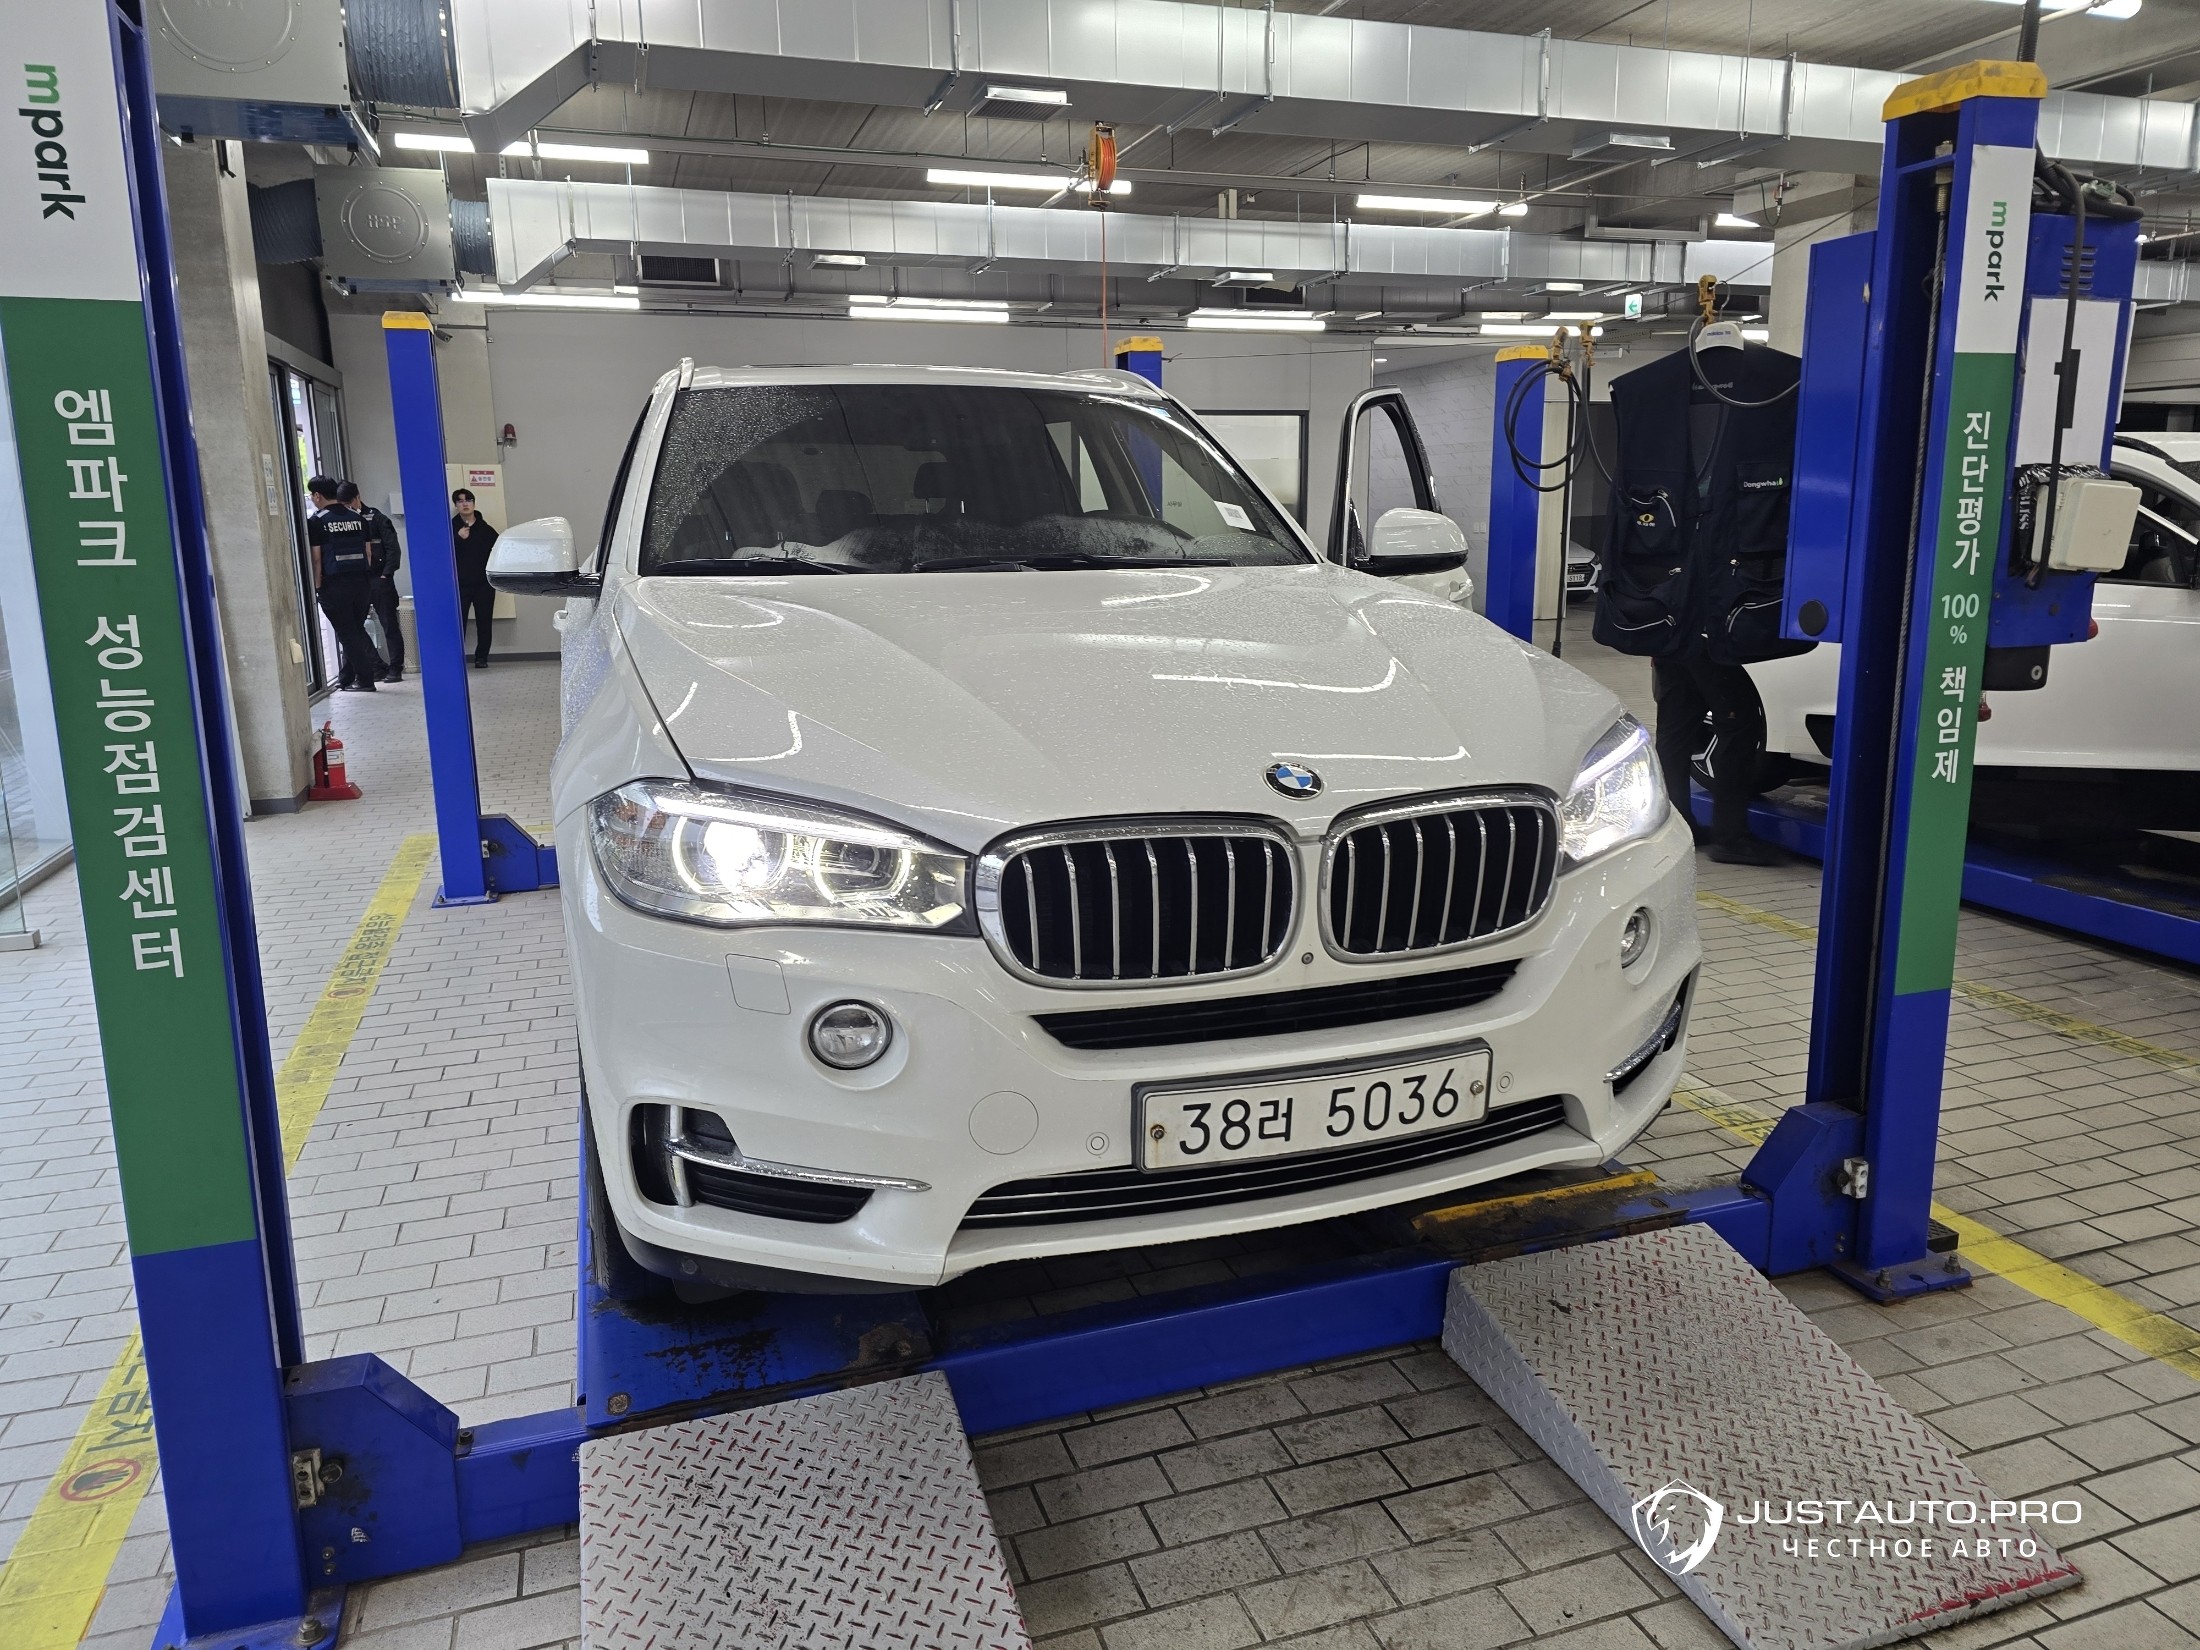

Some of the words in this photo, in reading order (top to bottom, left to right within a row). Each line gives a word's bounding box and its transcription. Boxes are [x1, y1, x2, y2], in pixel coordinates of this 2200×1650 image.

[19, 63, 86, 221] mpark
[1984, 201, 2008, 303] mpark
[55, 389, 137, 566] 엠파크
[328, 520, 362, 533] SECURITY
[1952, 411, 1991, 576] 진단평가
[1931, 665, 1967, 784] 책임제
[85, 614, 184, 978] 성능점검센터
[1178, 1098, 1293, 1156] 38러
[1325, 1067, 1459, 1138] 5036
